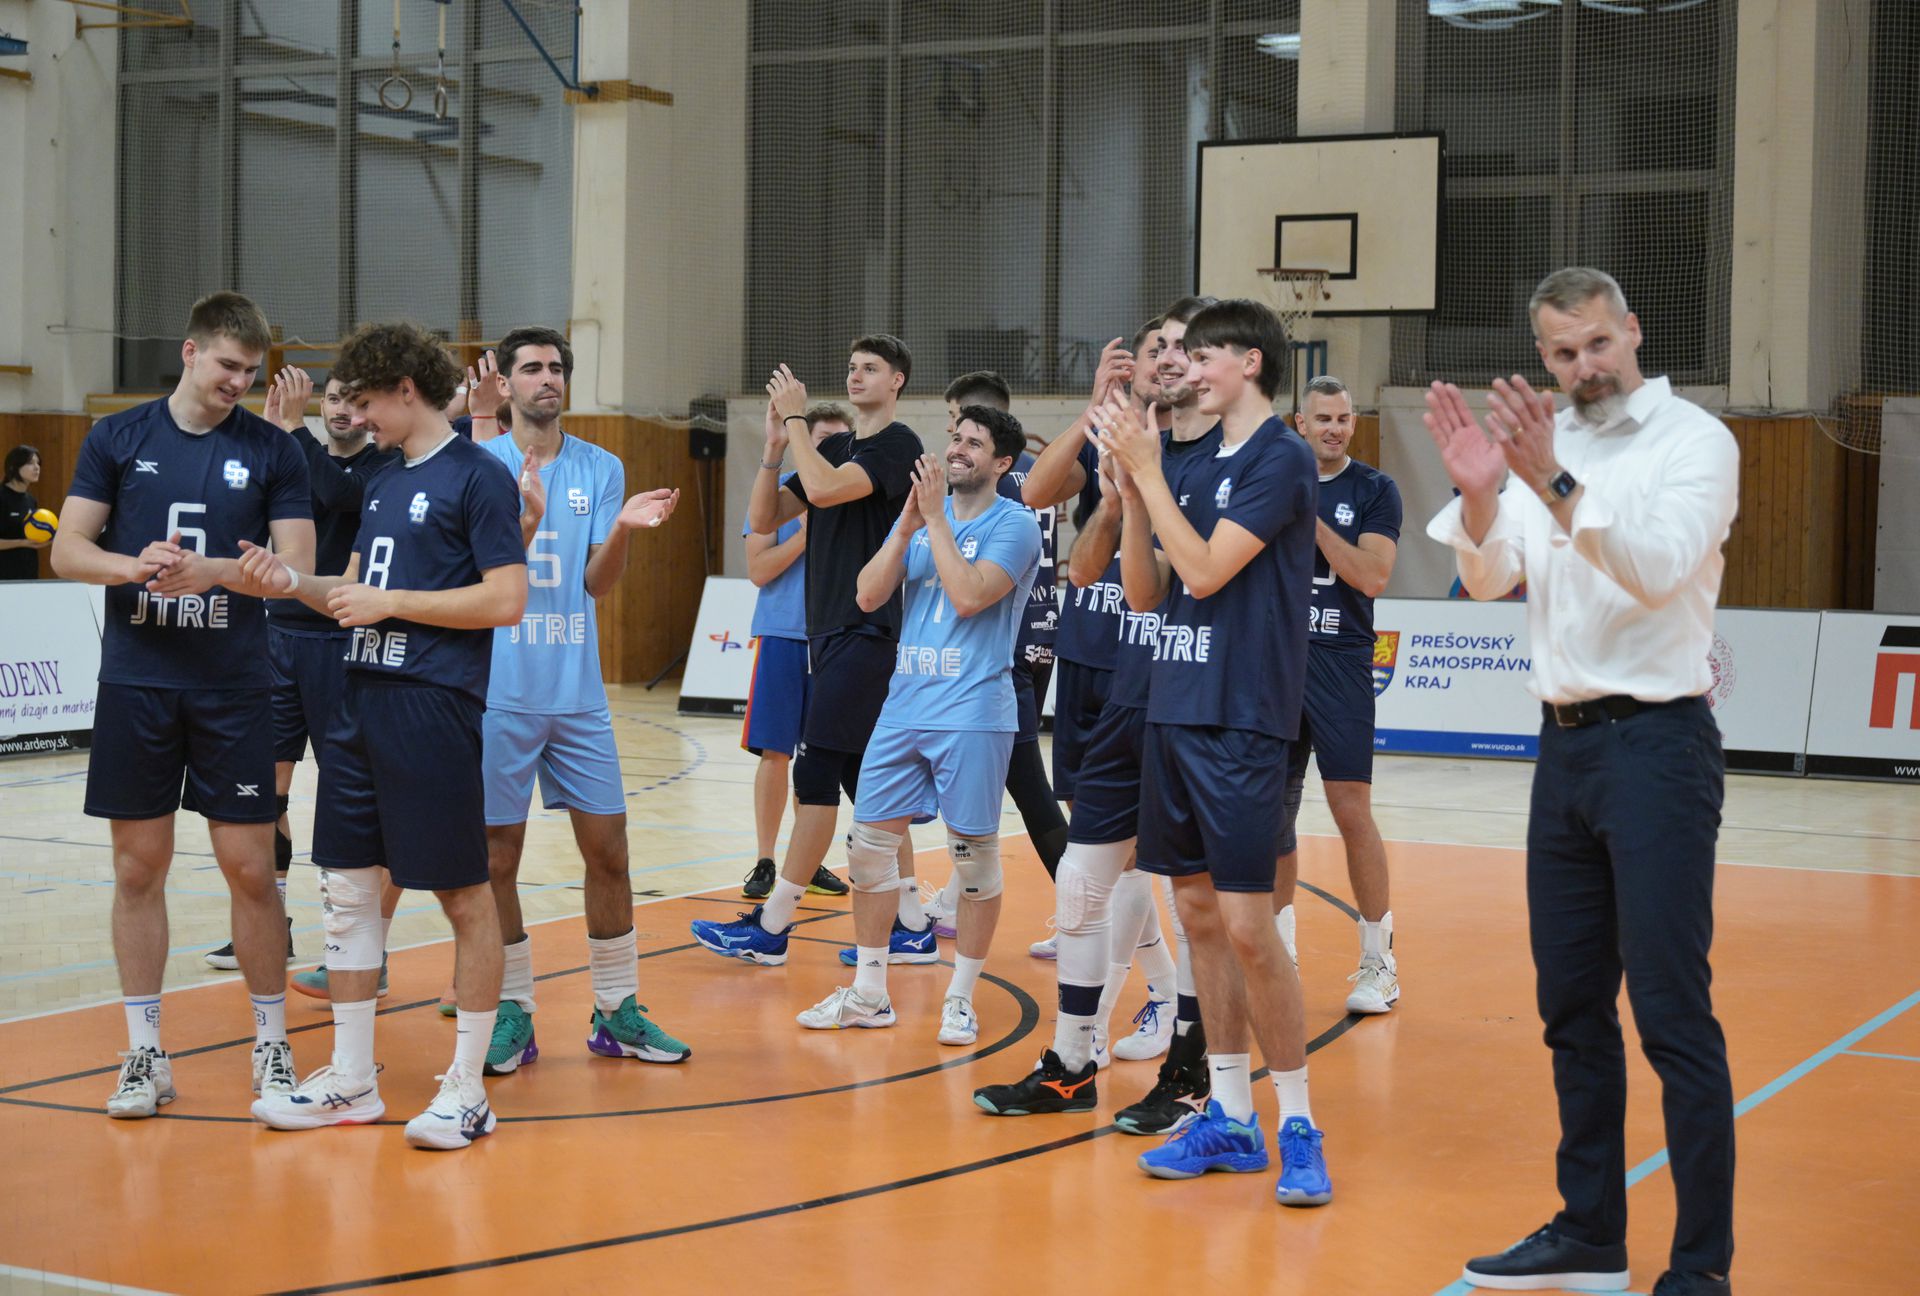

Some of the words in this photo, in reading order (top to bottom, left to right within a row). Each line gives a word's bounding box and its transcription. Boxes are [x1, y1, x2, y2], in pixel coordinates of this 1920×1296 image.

[365, 536, 394, 590] 8
[528, 531, 561, 587] 5
[130, 591, 228, 628] JTRE
[344, 627, 407, 667] TRE
[1411, 633, 1515, 650] PREŠOVSKÝ
[1409, 655, 1531, 671] SAMOSPRÁVN
[1405, 676, 1451, 689] KRAJ
